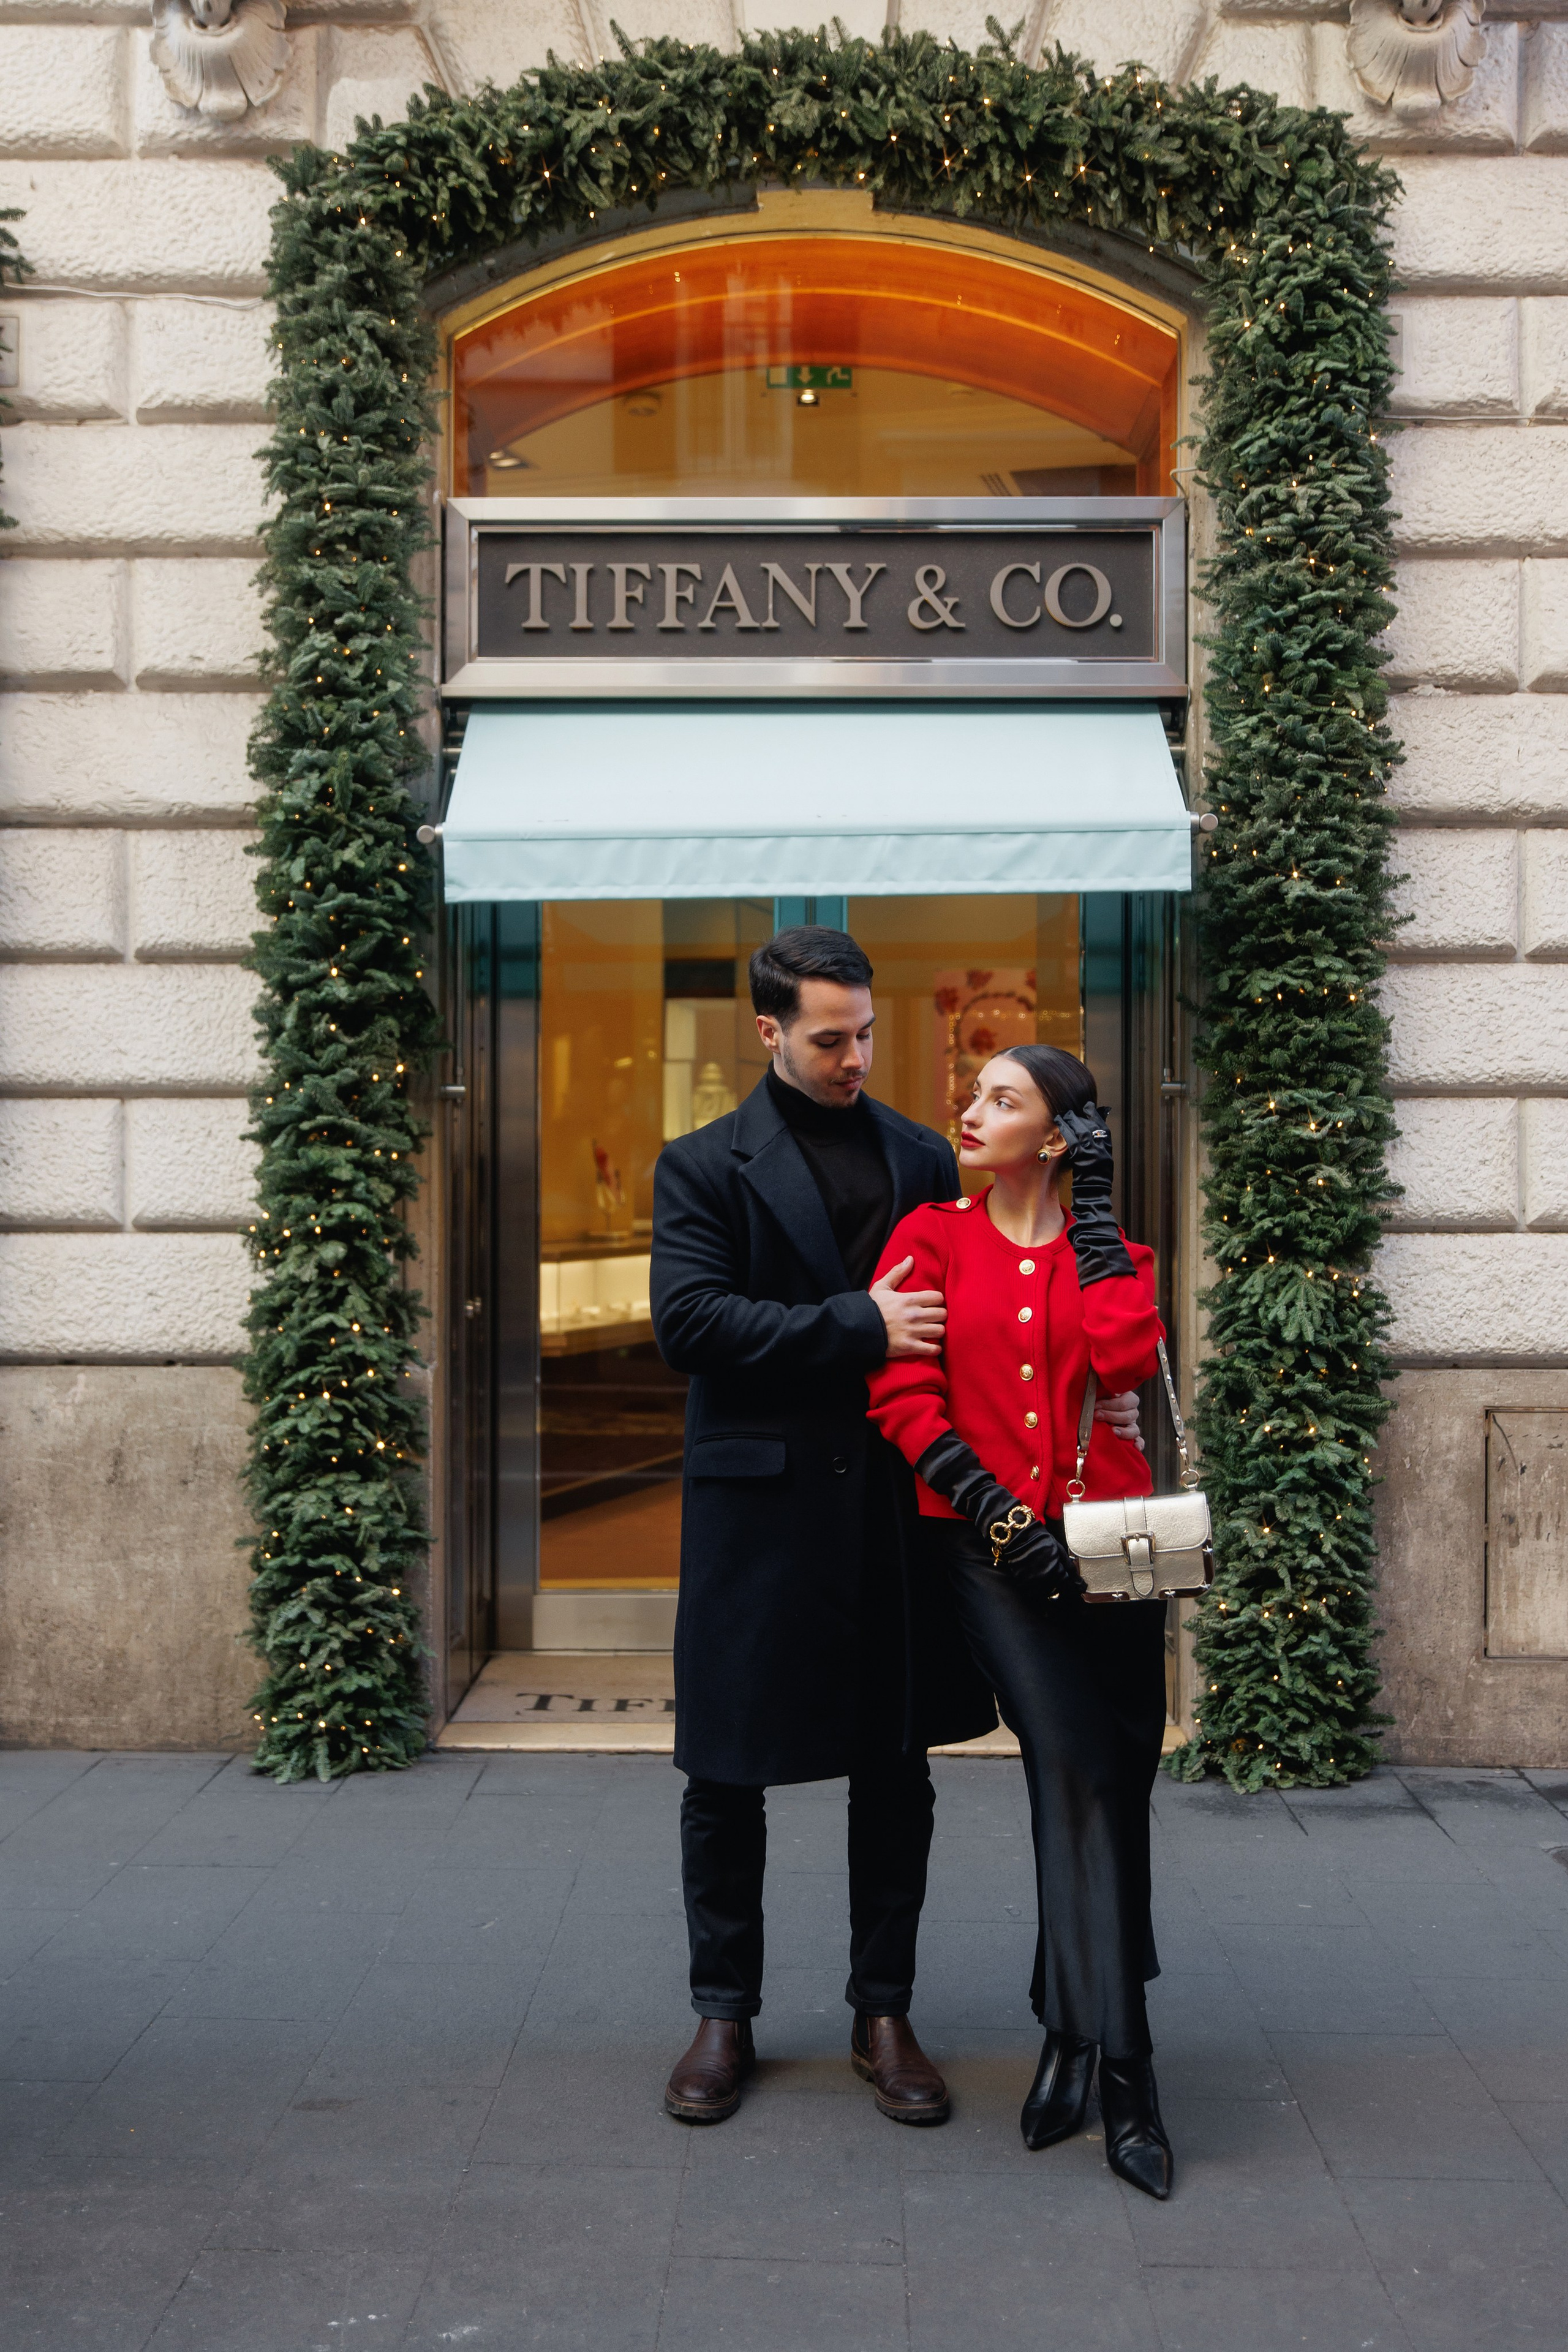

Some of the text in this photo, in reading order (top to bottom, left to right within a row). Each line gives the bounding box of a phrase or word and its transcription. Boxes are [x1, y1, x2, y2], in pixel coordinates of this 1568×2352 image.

[505, 561, 1123, 630] TIFFANY & CO.
